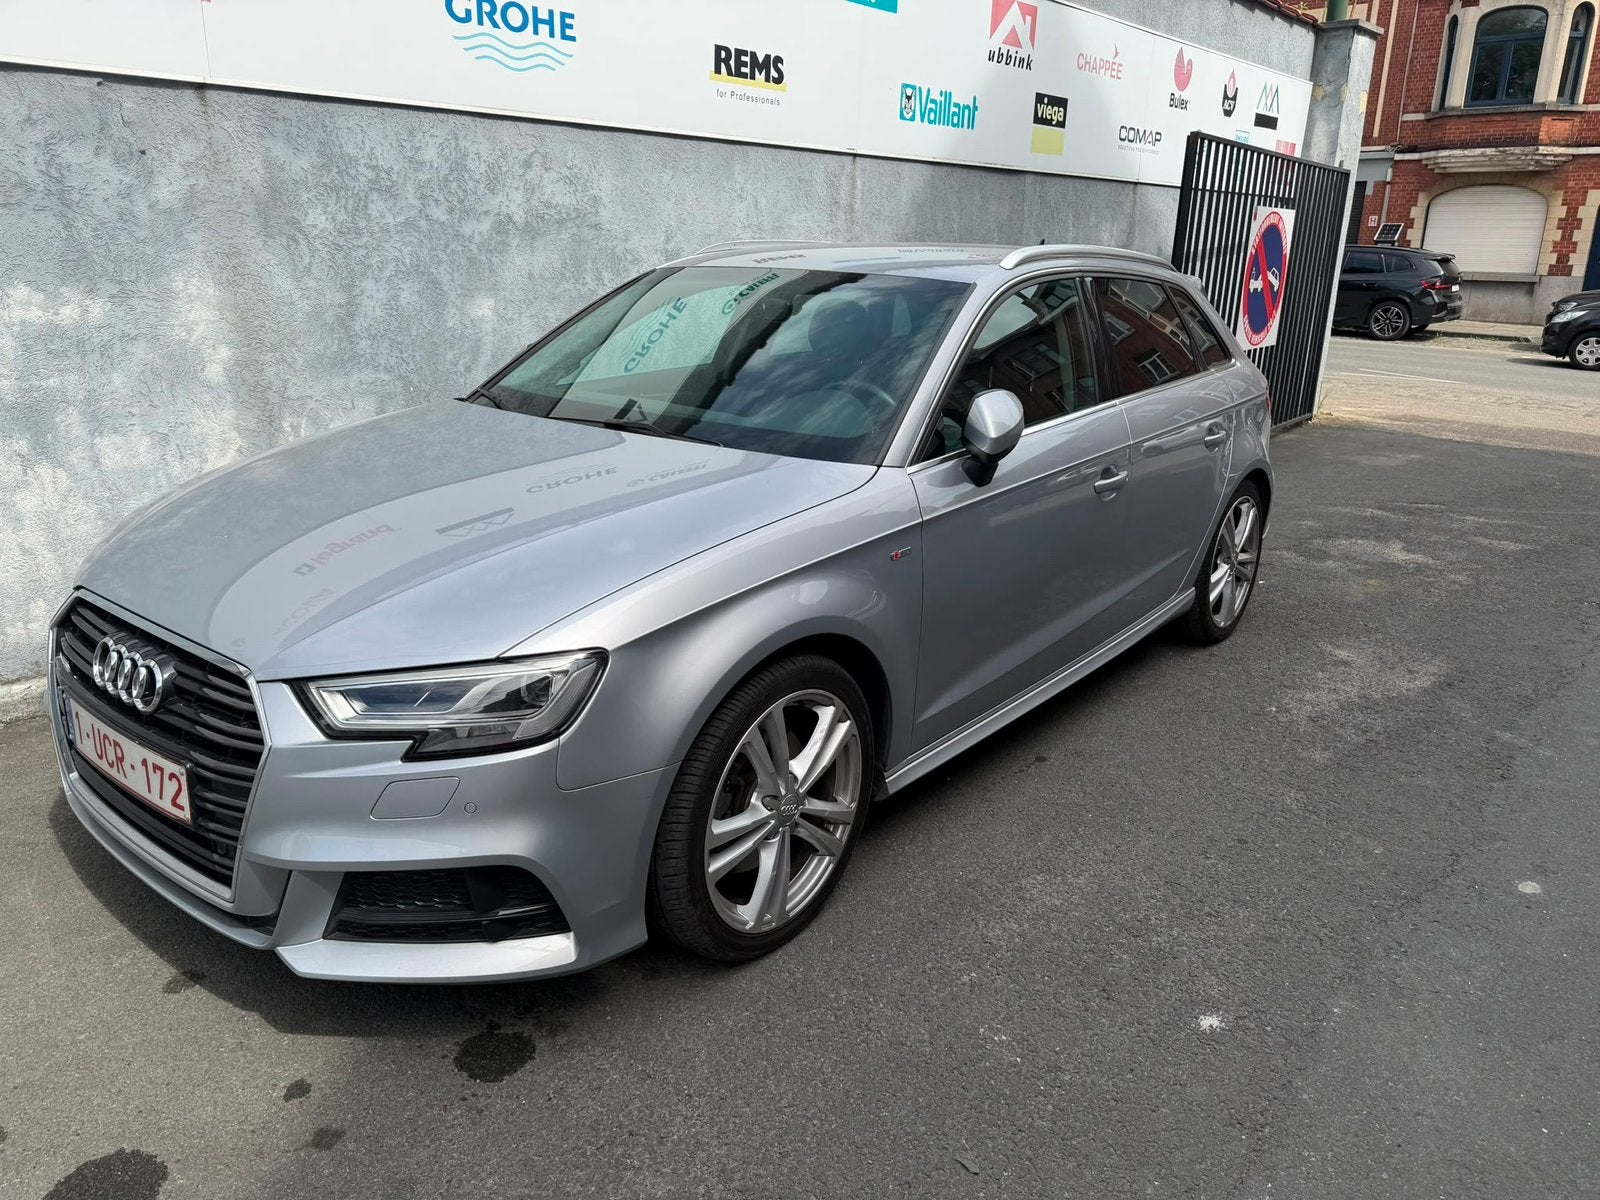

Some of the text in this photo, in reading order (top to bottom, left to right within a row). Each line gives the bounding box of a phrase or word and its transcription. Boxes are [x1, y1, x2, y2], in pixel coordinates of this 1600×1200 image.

[445, 0, 577, 42] GROHE
[714, 44, 785, 85] REMS
[987, 47, 1033, 71] ubbink
[716, 89, 781, 106] for Professionals
[918, 86, 979, 130] Vaillant
[1037, 97, 1065, 125] viega
[1169, 92, 1188, 111] Bulex
[1118, 125, 1162, 147] COMAP
[75, 711, 185, 812] 1-UCR-172
